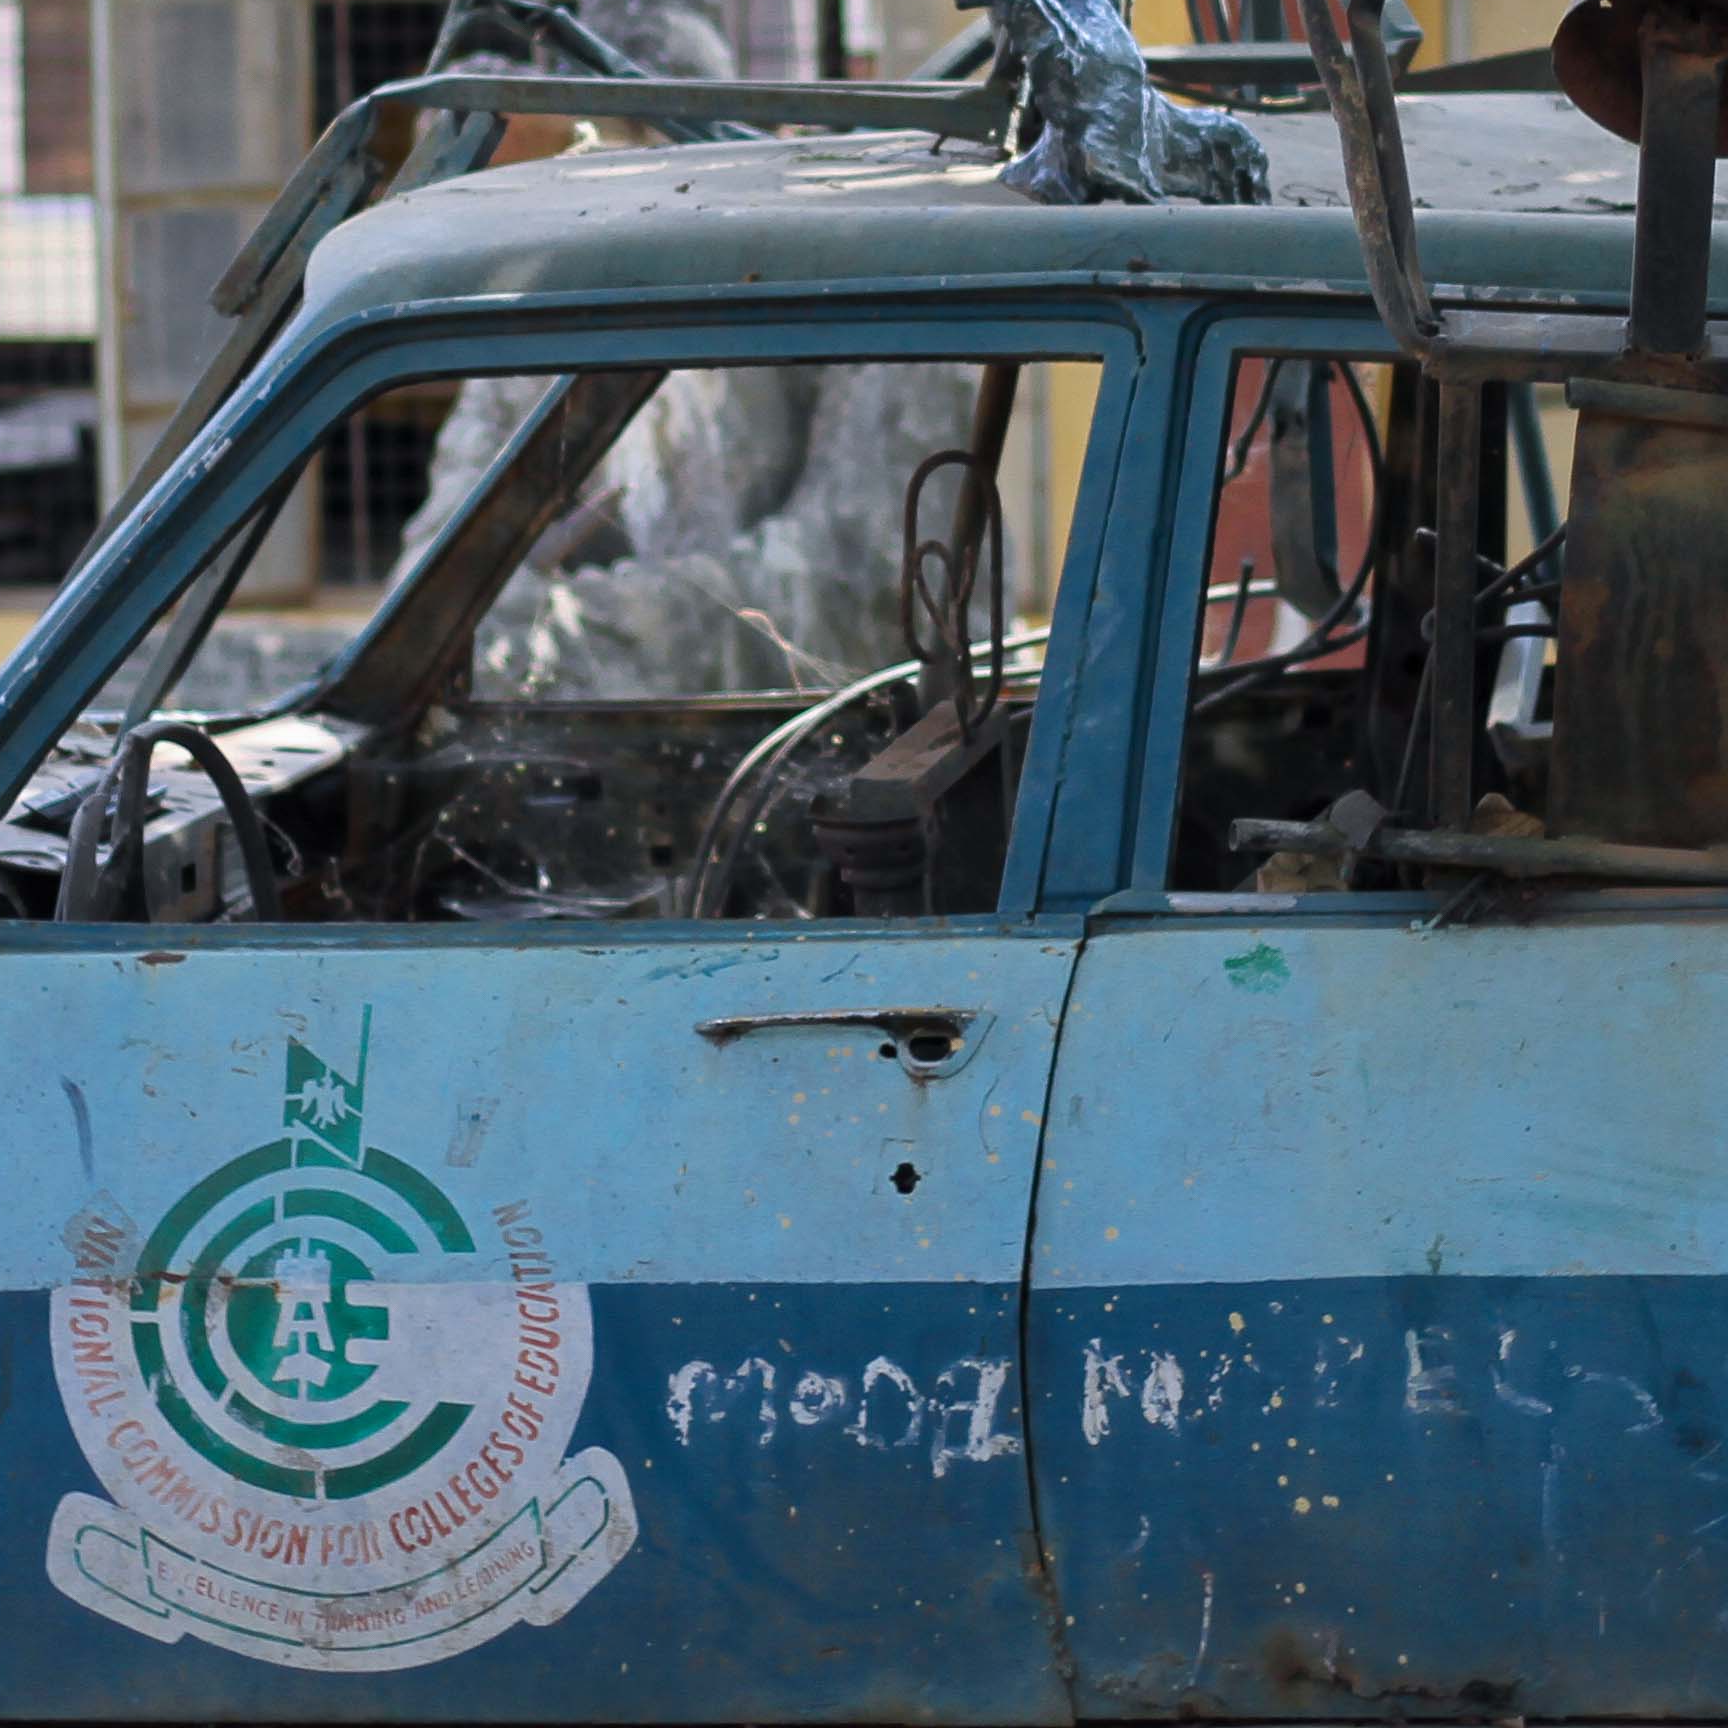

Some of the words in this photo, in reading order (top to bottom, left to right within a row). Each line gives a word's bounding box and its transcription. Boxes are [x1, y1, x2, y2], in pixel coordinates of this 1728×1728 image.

[69, 1215, 129, 1417] NATIONAL
[491, 1198, 561, 1397] EDUCATION
[501, 1392, 544, 1441] OF
[107, 1419, 311, 1566] COMMISSION
[320, 1520, 384, 1567] FOR
[389, 1430, 524, 1553] COLLEGES
[157, 1560, 280, 1623] ECELLENCE
[284, 1608, 305, 1628] IN
[414, 1591, 452, 1618] AND
